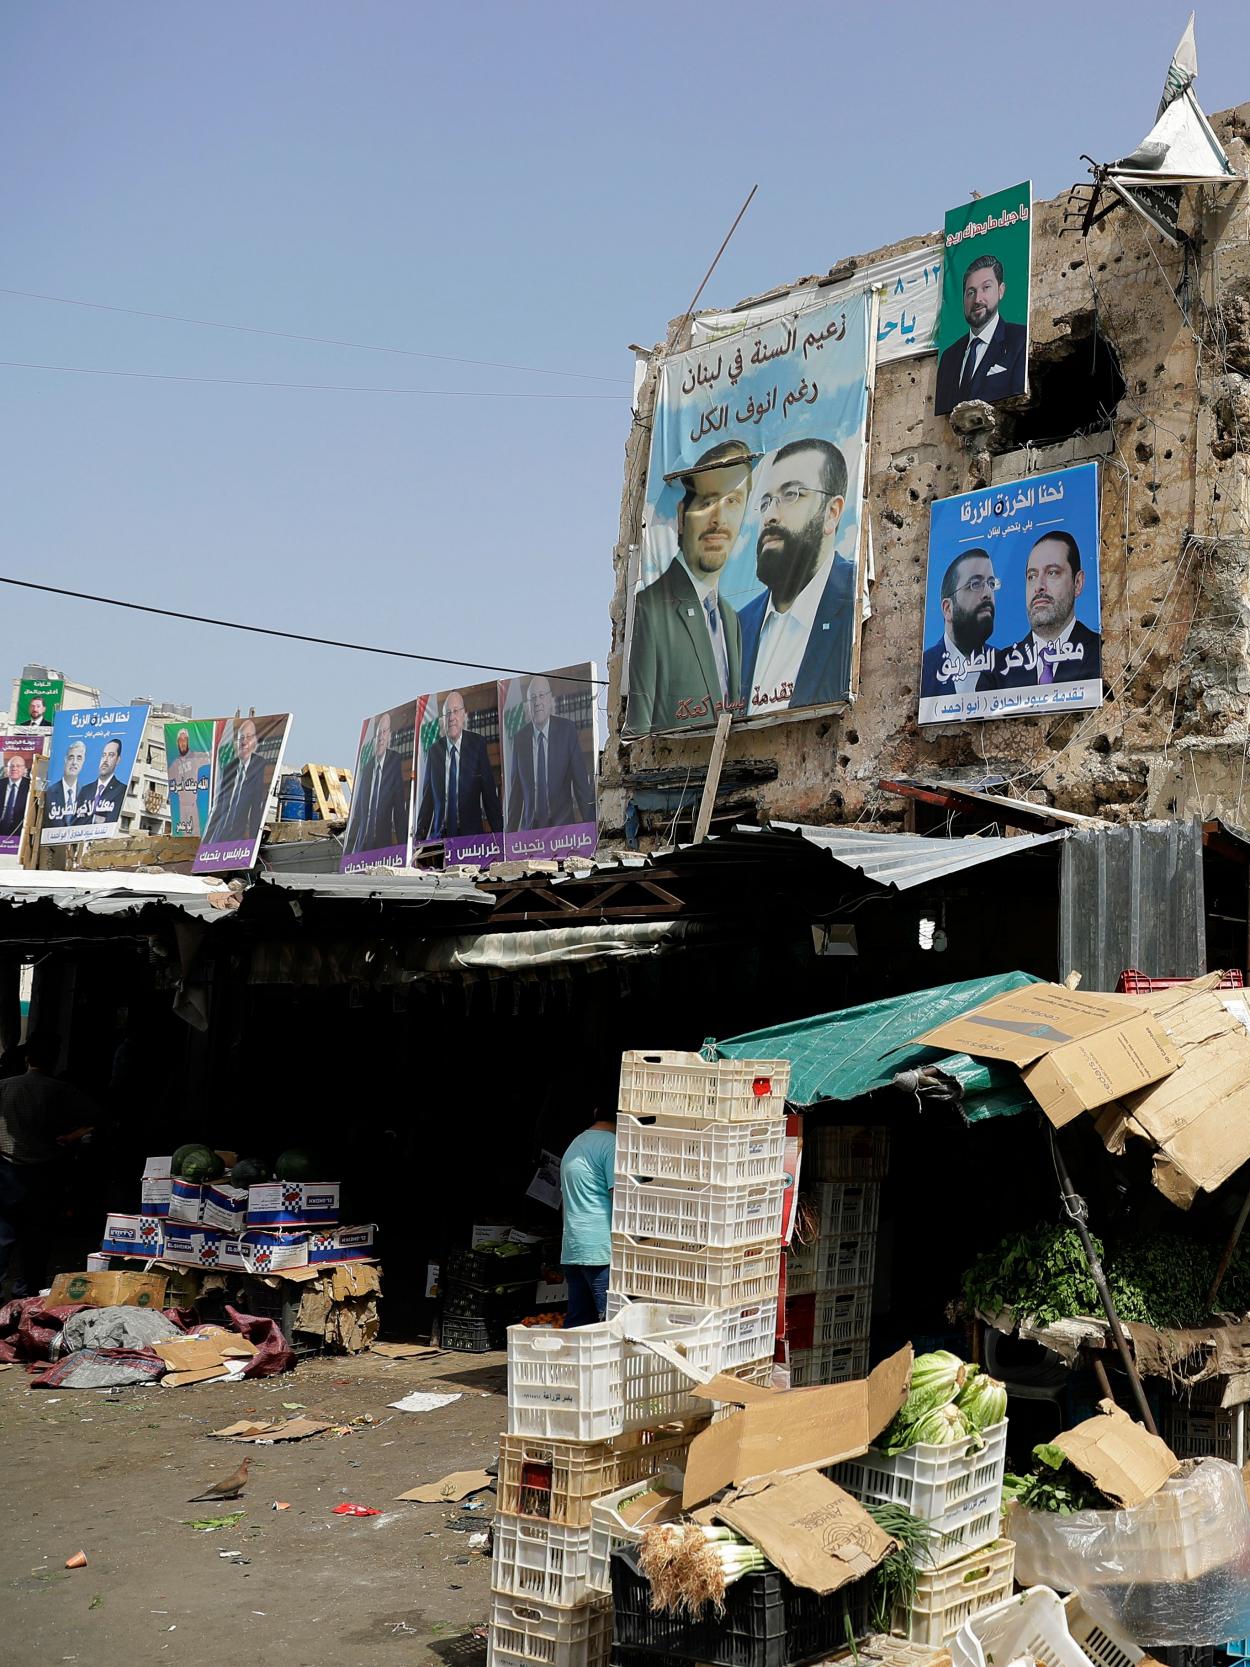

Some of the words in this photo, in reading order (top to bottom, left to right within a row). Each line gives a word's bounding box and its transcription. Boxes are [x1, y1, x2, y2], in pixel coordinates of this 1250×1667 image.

[998, 210, 1019, 227] جبل
[1020, 203, 1028, 221] يا
[987, 215, 998, 230] ما
[946, 231, 962, 247] ريح
[750, 326, 797, 365] السنة
[803, 313, 847, 360] زعيم
[682, 354, 722, 395] لبنان
[728, 347, 743, 386] في
[736, 385, 777, 424] انوف
[783, 377, 818, 419] رغم
[690, 404, 729, 443] الكل
[993, 487, 1035, 517] الخرزة
[1038, 481, 1064, 504] نحنا
[960, 497, 992, 525] الزرقا
[987, 526, 1001, 539] لبنان
[1000, 641, 1039, 676] لأخر
[1043, 638, 1084, 664] معك
[936, 647, 996, 685] الطريق
[714, 690, 746, 716] بسام
[752, 681, 794, 706] تقدمة
[1024, 694, 1049, 709] عبود
[1053, 687, 1085, 704] تقدمة
[115, 711, 130, 722] نحنا
[674, 695, 712, 720] كعكة
[71, 713, 90, 728] الزرقا
[90, 711, 115, 727] الخرزة
[198, 775, 209, 790] الله
[48, 801, 78, 820] الطريق
[96, 799, 115, 812] معك
[511, 839, 545, 855] بتحبك
[550, 832, 592, 851] طرابلس
[200, 850, 221, 863] بتحبك
[222, 848, 251, 861] طرابلس
[457, 843, 500, 861] طرابلس
[1088, 1061, 1114, 1095] cedars
